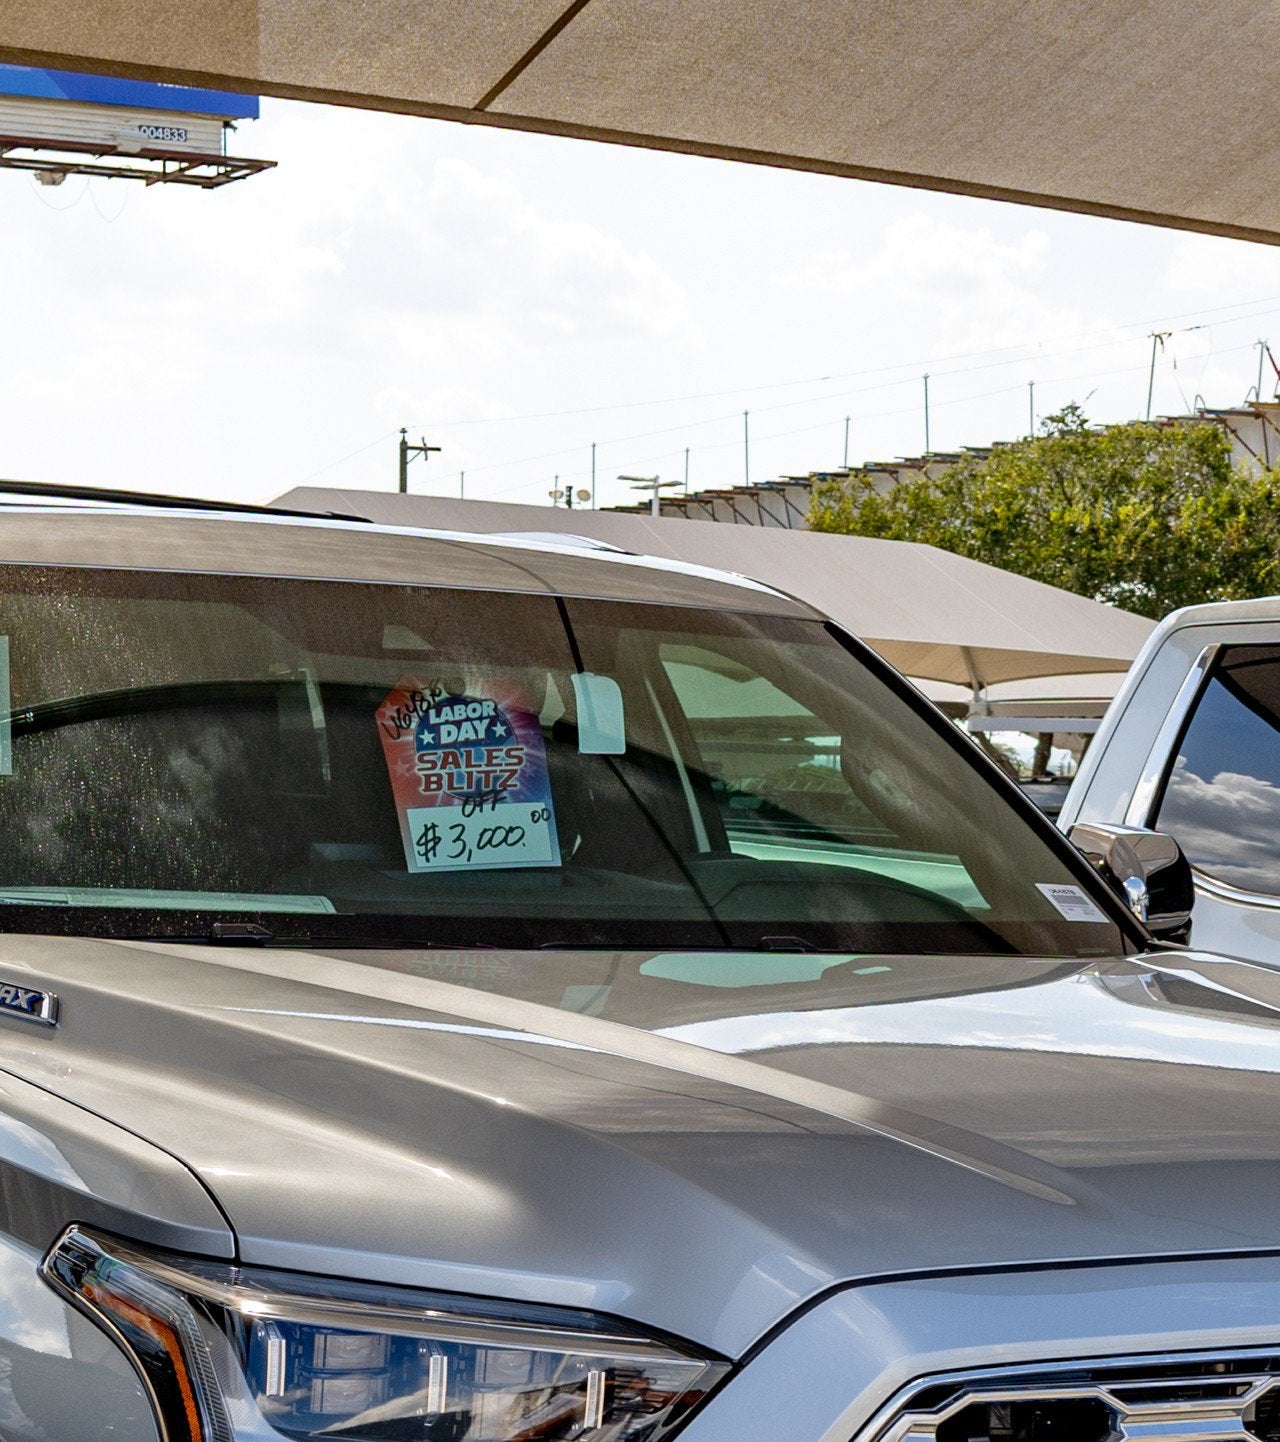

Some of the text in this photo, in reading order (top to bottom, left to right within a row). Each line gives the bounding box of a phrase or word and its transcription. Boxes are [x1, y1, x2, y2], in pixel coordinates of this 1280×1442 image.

[429, 700, 496, 725] LABOR
[440, 718, 491, 745] DAY
[416, 747, 525, 772] SALES
[421, 768, 519, 793] BLITZ
